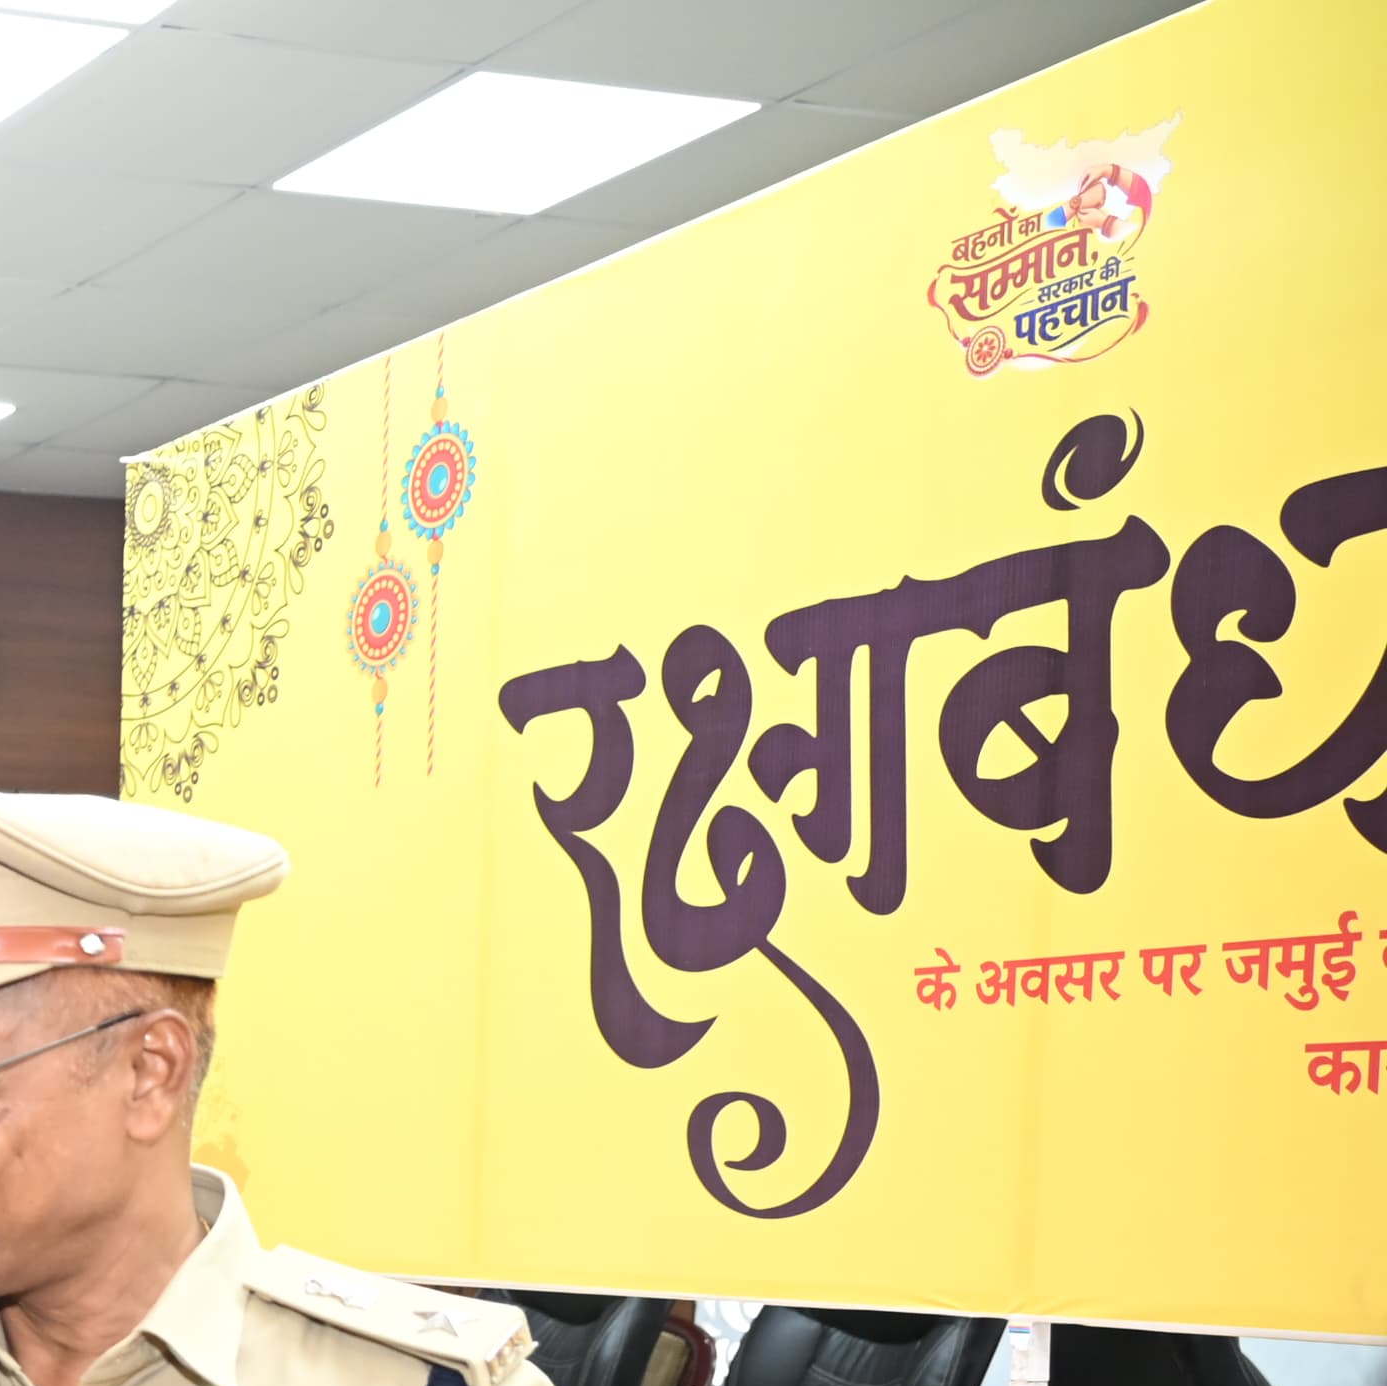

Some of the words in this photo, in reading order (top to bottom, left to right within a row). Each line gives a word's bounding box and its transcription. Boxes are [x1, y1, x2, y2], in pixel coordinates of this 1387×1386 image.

[951, 207, 1018, 262] बहनों
[1018, 212, 1043, 236] का
[949, 228, 1098, 321] सम्मान,
[1037, 269, 1097, 304] सरकार
[1099, 256, 1121, 285] की
[1014, 276, 1136, 345] पहचान
[914, 947, 961, 1012] के
[976, 951, 1125, 1007] अवसर
[1139, 944, 1207, 997] पर
[1222, 910, 1362, 1011] जमुई
[1305, 1040, 1387, 1096] का
